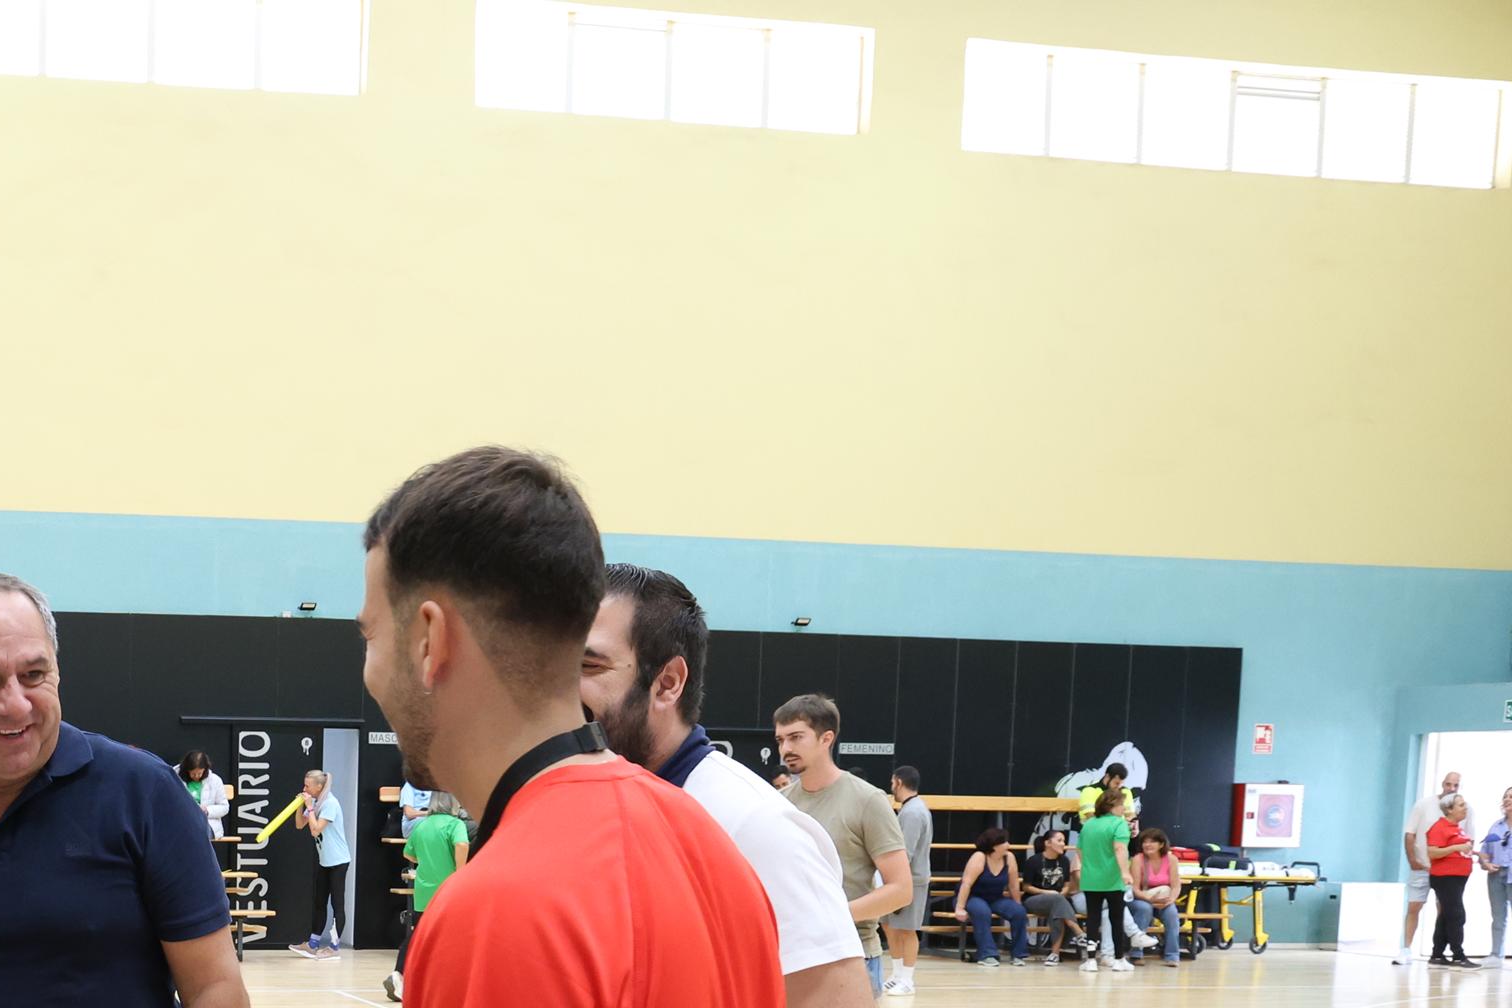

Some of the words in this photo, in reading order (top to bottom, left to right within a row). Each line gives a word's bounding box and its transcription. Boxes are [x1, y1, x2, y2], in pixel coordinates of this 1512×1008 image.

[370, 733, 397, 743] MASC
[841, 744, 893, 753] FEMENINO
[235, 731, 271, 944] VESTUARIO
